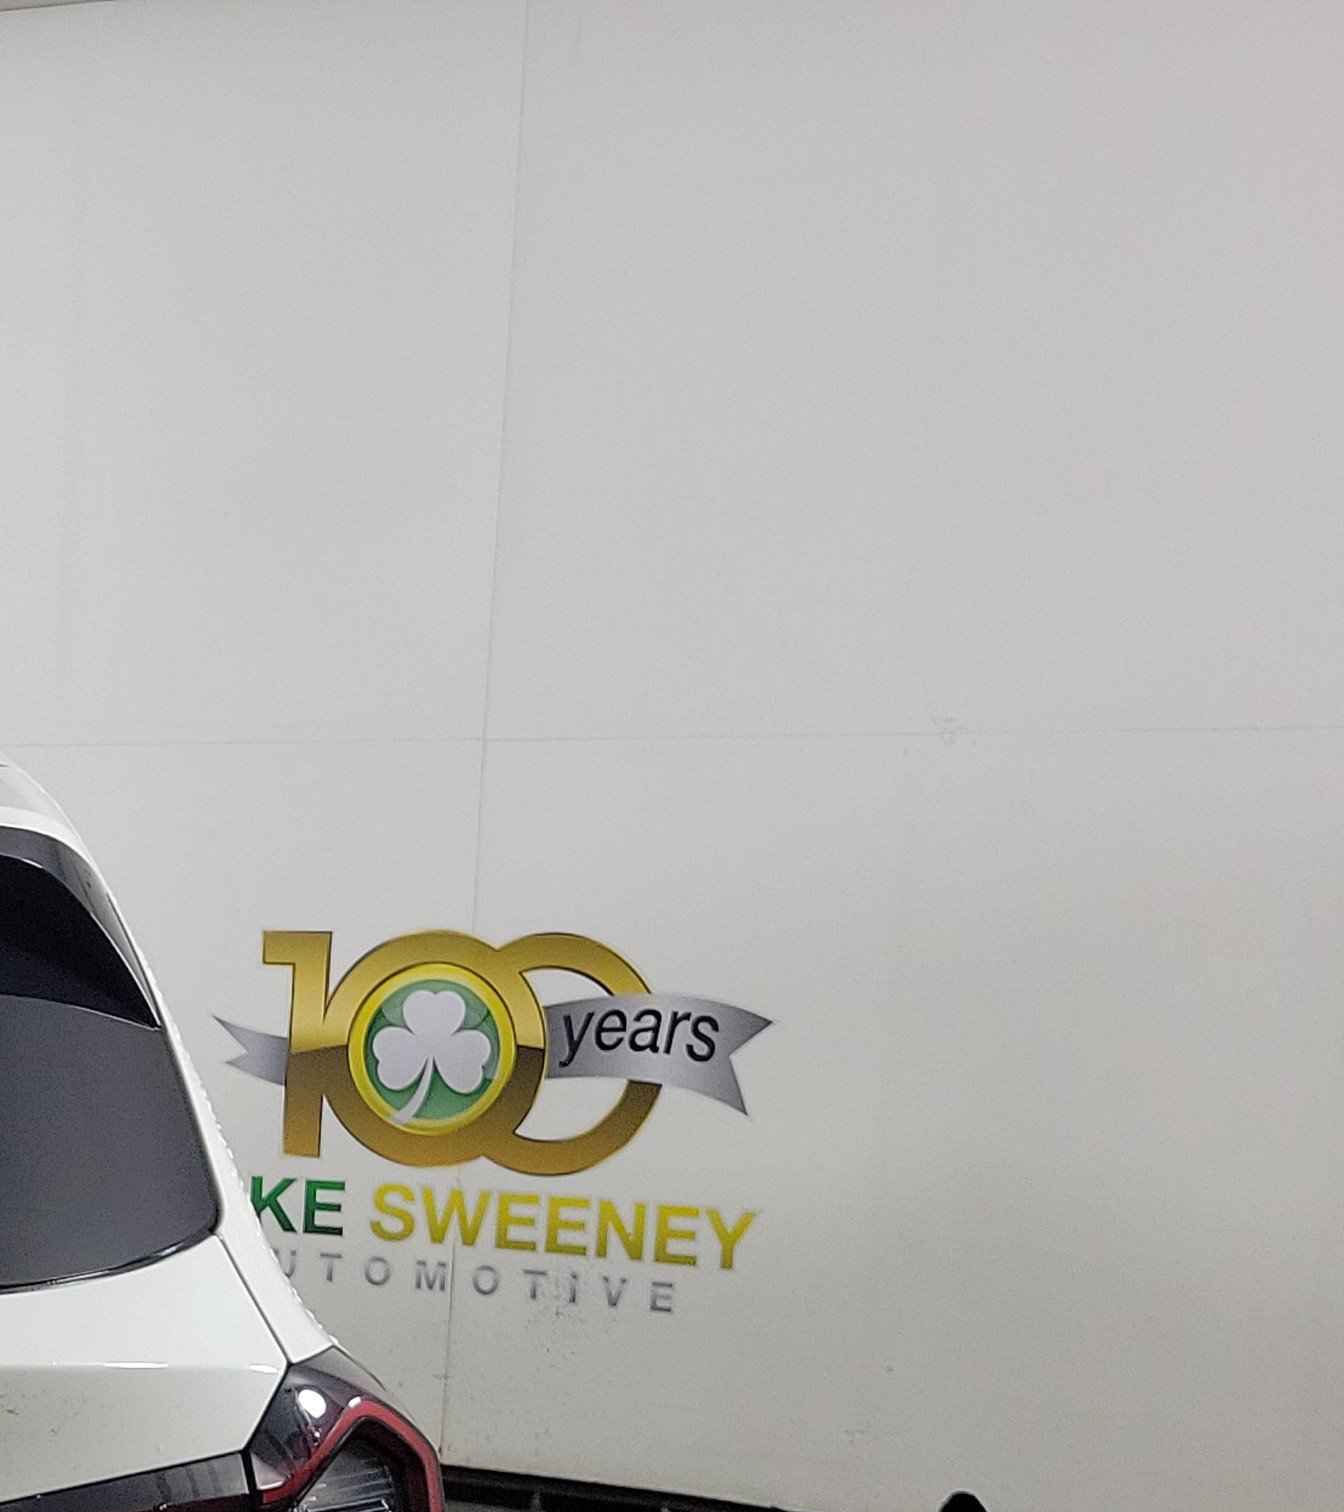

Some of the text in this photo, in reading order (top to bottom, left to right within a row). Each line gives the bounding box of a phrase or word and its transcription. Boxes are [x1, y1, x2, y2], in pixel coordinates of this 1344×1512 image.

[559, 1006, 719, 1068] years
[250, 1176, 757, 1271] KE SWEENEY
[273, 1248, 675, 1314] UTOMOTIVE
